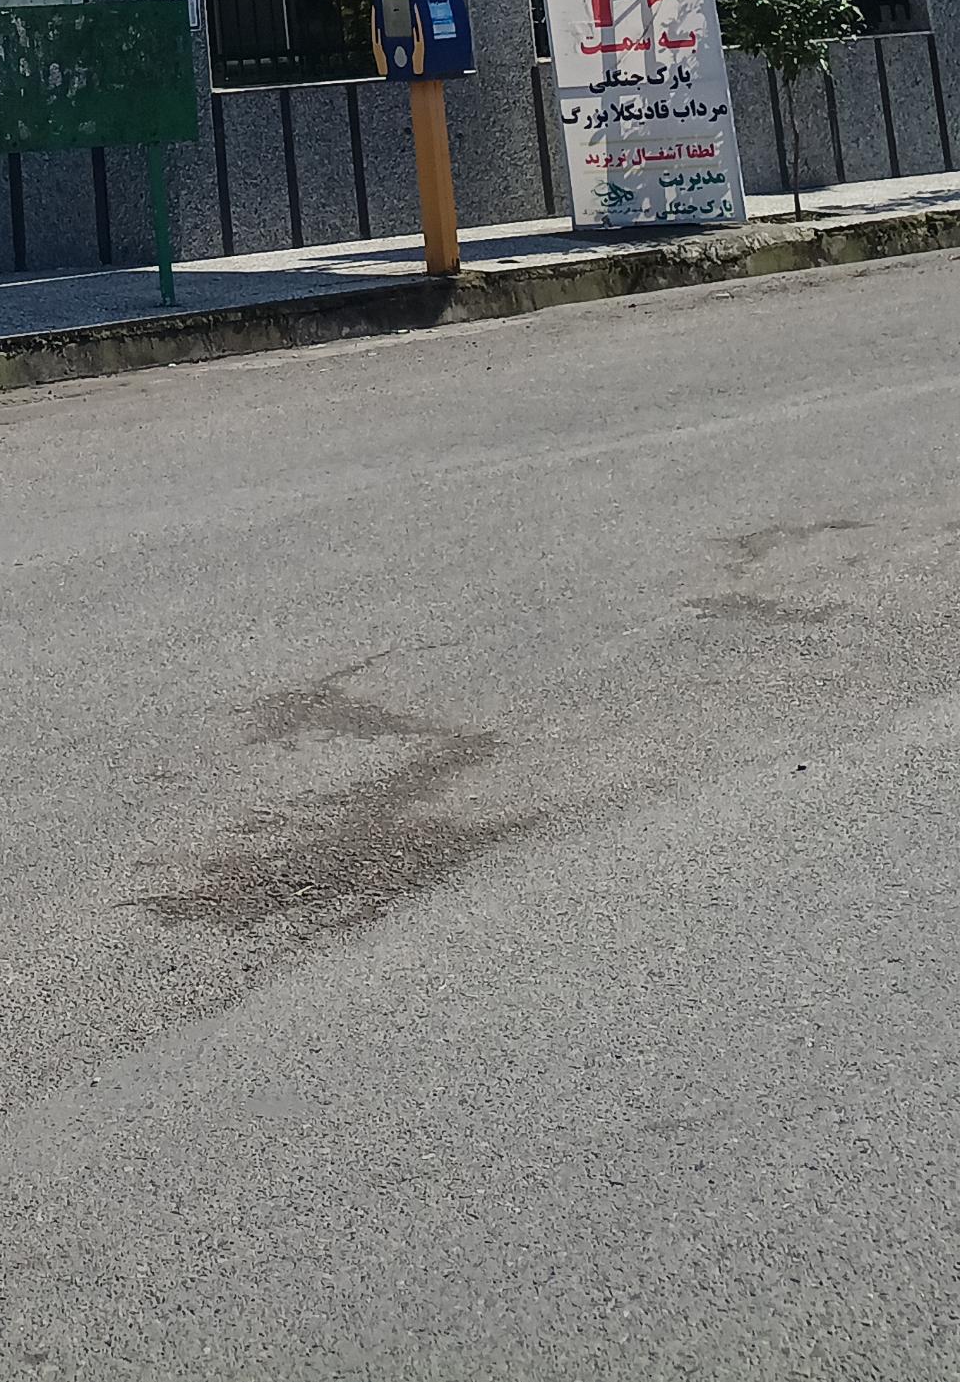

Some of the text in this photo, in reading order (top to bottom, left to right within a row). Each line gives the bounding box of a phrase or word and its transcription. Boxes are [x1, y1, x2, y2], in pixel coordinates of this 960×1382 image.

[580, 30, 697, 55] به سمت
[589, 66, 692, 95] پارک جنگلی
[561, 99, 728, 130] مرداب قادیکلا بزرگ
[585, 142, 715, 169] لطفا آشغال نریزید
[658, 169, 726, 191] مدیریت
[655, 201, 698, 221] جنگلی
[699, 199, 733, 218] پارک
